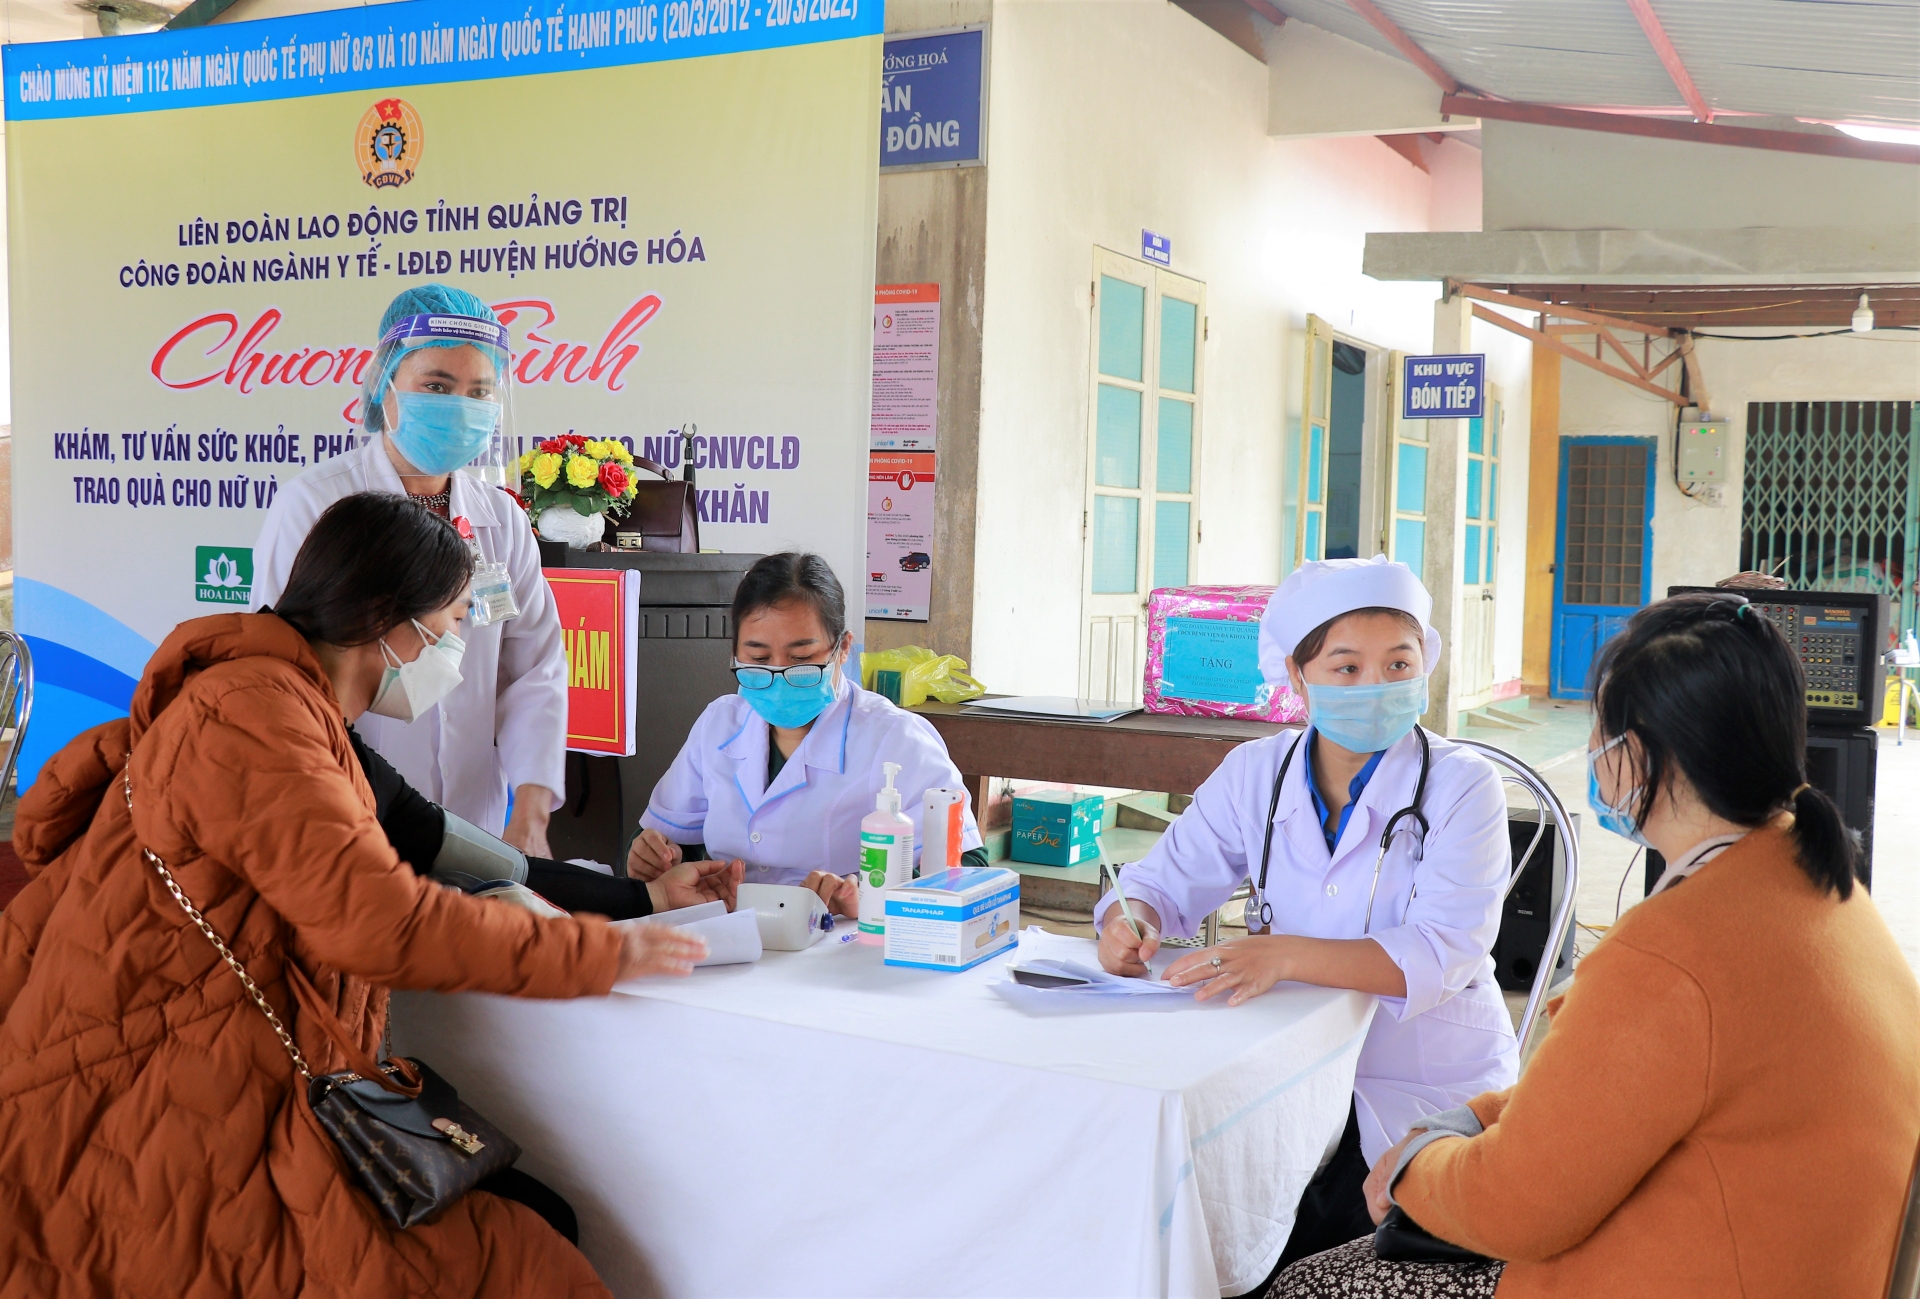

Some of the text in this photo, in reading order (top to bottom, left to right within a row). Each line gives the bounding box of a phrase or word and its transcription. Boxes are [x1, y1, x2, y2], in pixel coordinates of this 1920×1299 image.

[20, 63, 52, 103] CHÀO
[55, 61, 91, 101] MỪNG
[94, 54, 109, 98] KỶ
[112, 56, 144, 103] NIỆM
[147, 59, 169, 93] 112
[172, 50, 202, 91] NĂM
[205, 46, 240, 88] NGÀY
[243, 36, 278, 87] QUỐC
[281, 34, 297, 80] TẾ
[299, 41, 327, 84] PHỤ
[330, 32, 351, 75] NỮ
[352, 35, 374, 72] 8/3
[377, 26, 396, 69] VÀ
[400, 31, 417, 67] 10
[420, 21, 455, 65] NĂM
[458, 17, 498, 62] NGÀY
[501, 6, 542, 62] QUỐC
[546, 3, 565, 53] TẾ
[568, 10, 611, 58] HẠNH
[615, 0, 658, 45] PHÚC
[662, 0, 749, 44] (20/3/2012
[755, 8, 762, 17] -
[883, 47, 948, 70] ỚNG HOÁ
[881, 75, 911, 113] ẤN
[886, 112, 960, 152] ĐỒNG
[178, 193, 628, 246] LIÊN ĐOÀN LAO ĐỘNG TỈNH QUẢNG TRỊ
[119, 259, 180, 288] CÔNG
[186, 255, 246, 285] ĐOÀN
[253, 251, 330, 283] NGÀNH
[337, 254, 350, 278] Y
[356, 242, 382, 278] TẾ
[398, 250, 452, 276] LĐLĐ
[460, 240, 536, 279] HUYỆN
[545, 235, 638, 270] HƯỚNG
[647, 229, 706, 265] HÓA
[1413, 362, 1475, 378] KHU VỰC
[1411, 379, 1476, 409] ĐÓN TIẾP
[54, 427, 115, 464] KHÁM,
[122, 430, 147, 461] TƯ
[151, 424, 190, 462] VẤN
[197, 427, 238, 463] SỨC
[245, 424, 306, 467] KHỎE,
[644, 429, 685, 470] NỮ
[694, 435, 800, 470] CNVCLĐ
[73, 472, 770, 524] TRAO QUÀ CHO NỮ VÀ KHĂN
[200, 589, 250, 601] HOA LINH
[562, 617, 610, 690] HÁM
[1200, 657, 1233, 669] TẶNG
[1016, 831, 1042, 840] PAPER
[901, 906, 944, 916] TANAPHAR
